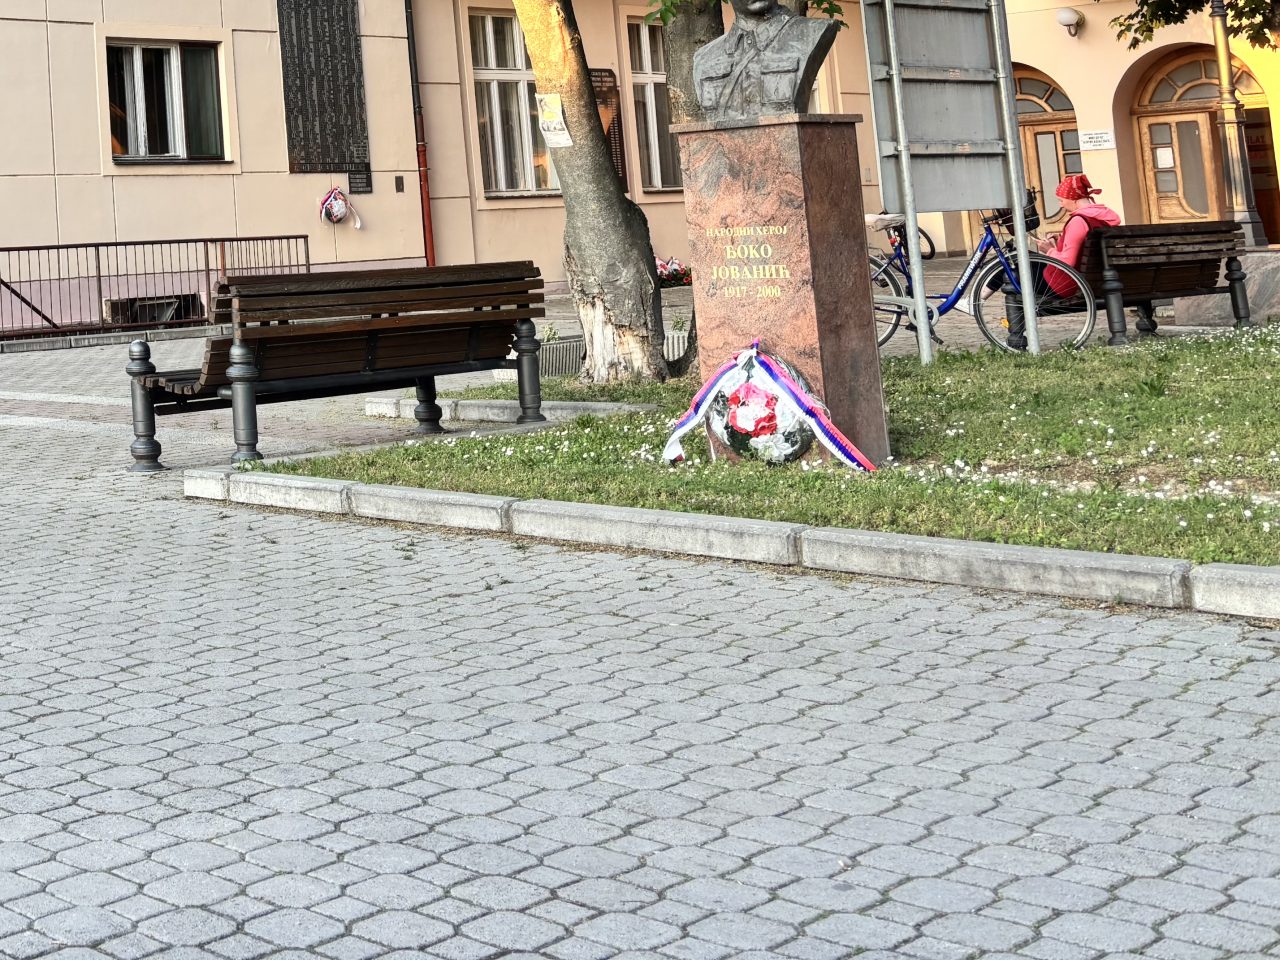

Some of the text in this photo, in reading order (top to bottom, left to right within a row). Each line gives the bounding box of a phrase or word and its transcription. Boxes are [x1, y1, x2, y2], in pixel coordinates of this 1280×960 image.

[706, 225, 787, 237] НАРОДНИ ХЕРОЈ
[957, 249, 983, 290] FRAMEWORK
[724, 286, 747, 298] 1917
[757, 285, 780, 297] 2000
